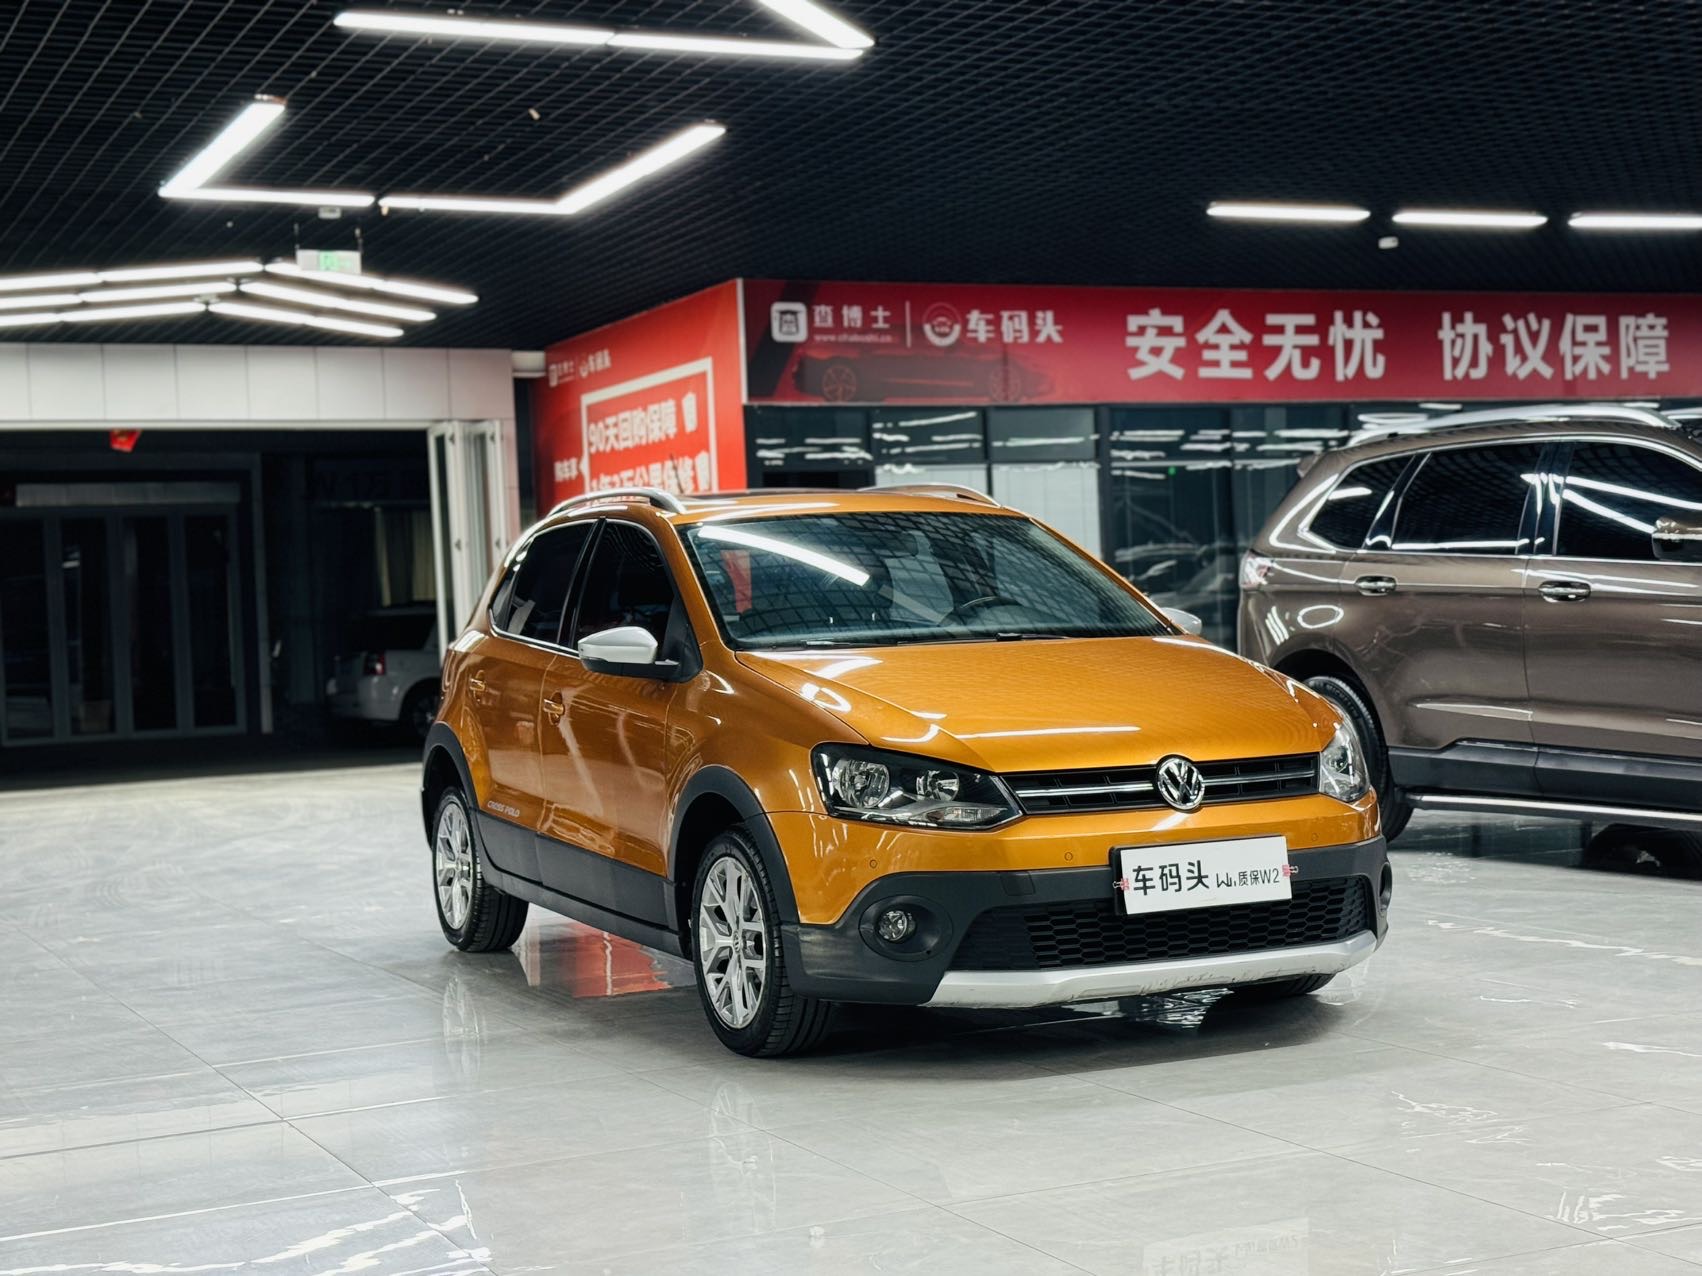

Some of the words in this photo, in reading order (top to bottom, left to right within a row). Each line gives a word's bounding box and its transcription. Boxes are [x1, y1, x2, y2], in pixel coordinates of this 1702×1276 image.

[812, 304, 891, 329] 查博士
[966, 309, 1063, 344] 车码头
[1125, 307, 1386, 382] 安全无忧
[1438, 311, 1671, 382] 协议保障
[589, 398, 677, 455] 90天回购保障
[504, 806, 521, 818] POLO
[1132, 860, 1209, 896] 车码头
